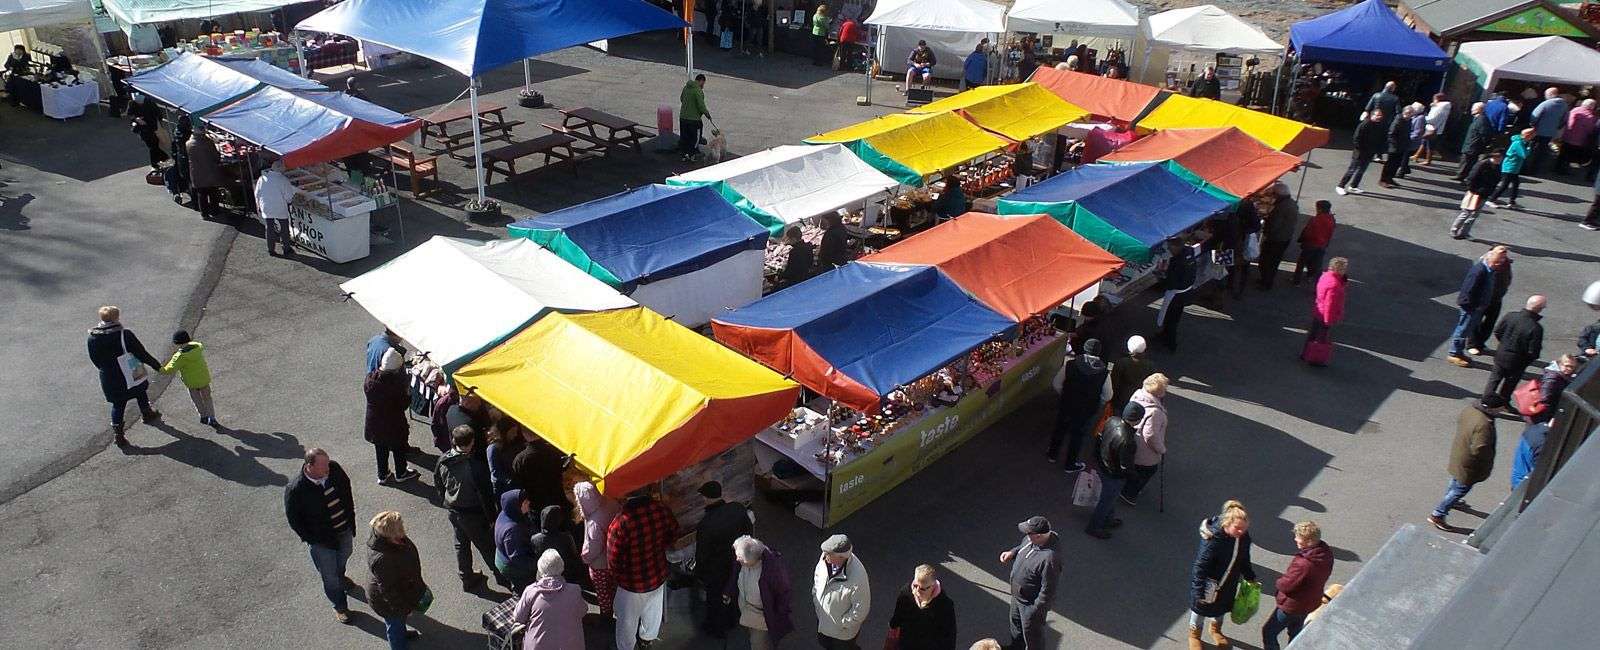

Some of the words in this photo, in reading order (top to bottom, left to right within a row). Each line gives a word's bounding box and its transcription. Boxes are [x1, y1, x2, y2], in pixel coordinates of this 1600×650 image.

[298, 220, 324, 242] SHOP
[920, 414, 959, 448] taste
[839, 474, 864, 495] taste
